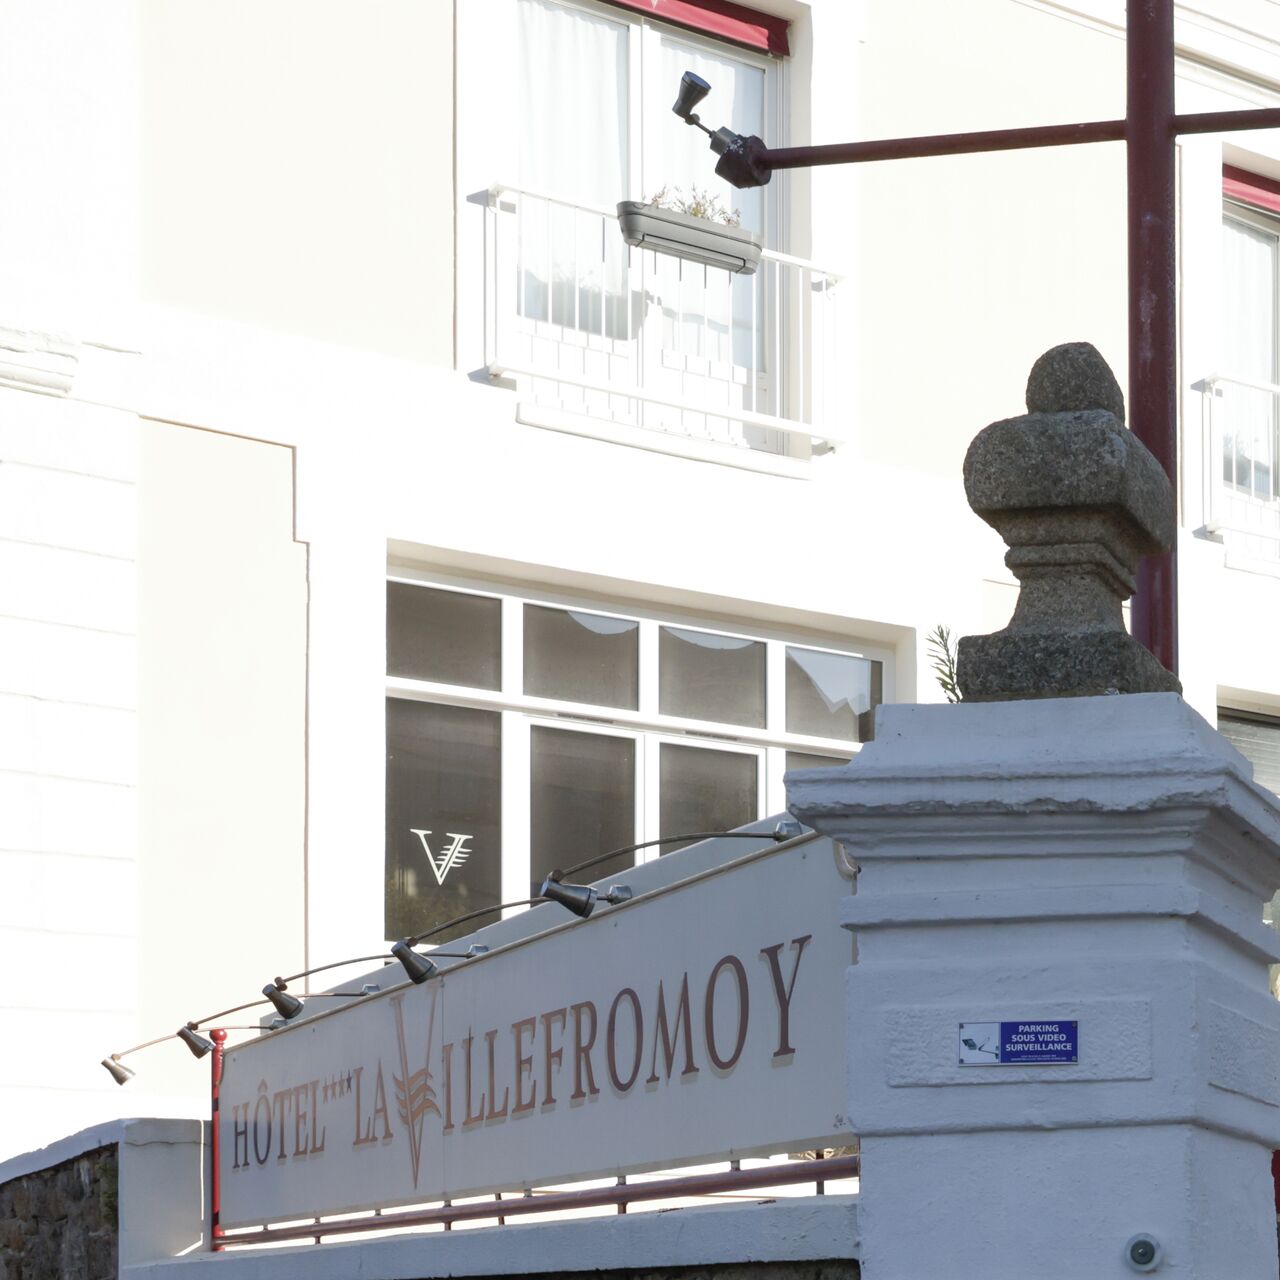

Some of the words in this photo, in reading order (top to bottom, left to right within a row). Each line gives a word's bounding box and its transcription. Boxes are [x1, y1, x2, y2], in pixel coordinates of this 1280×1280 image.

[1018, 1024, 1059, 1033] PARKING
[1011, 1034, 1036, 1042] SOUS
[1037, 1033, 1067, 1042] VIDEO
[1005, 1042, 1073, 1052] SURVEILLANCE
[232, 1077, 327, 1169] HÔTEL
[352, 1056, 394, 1146] LA
